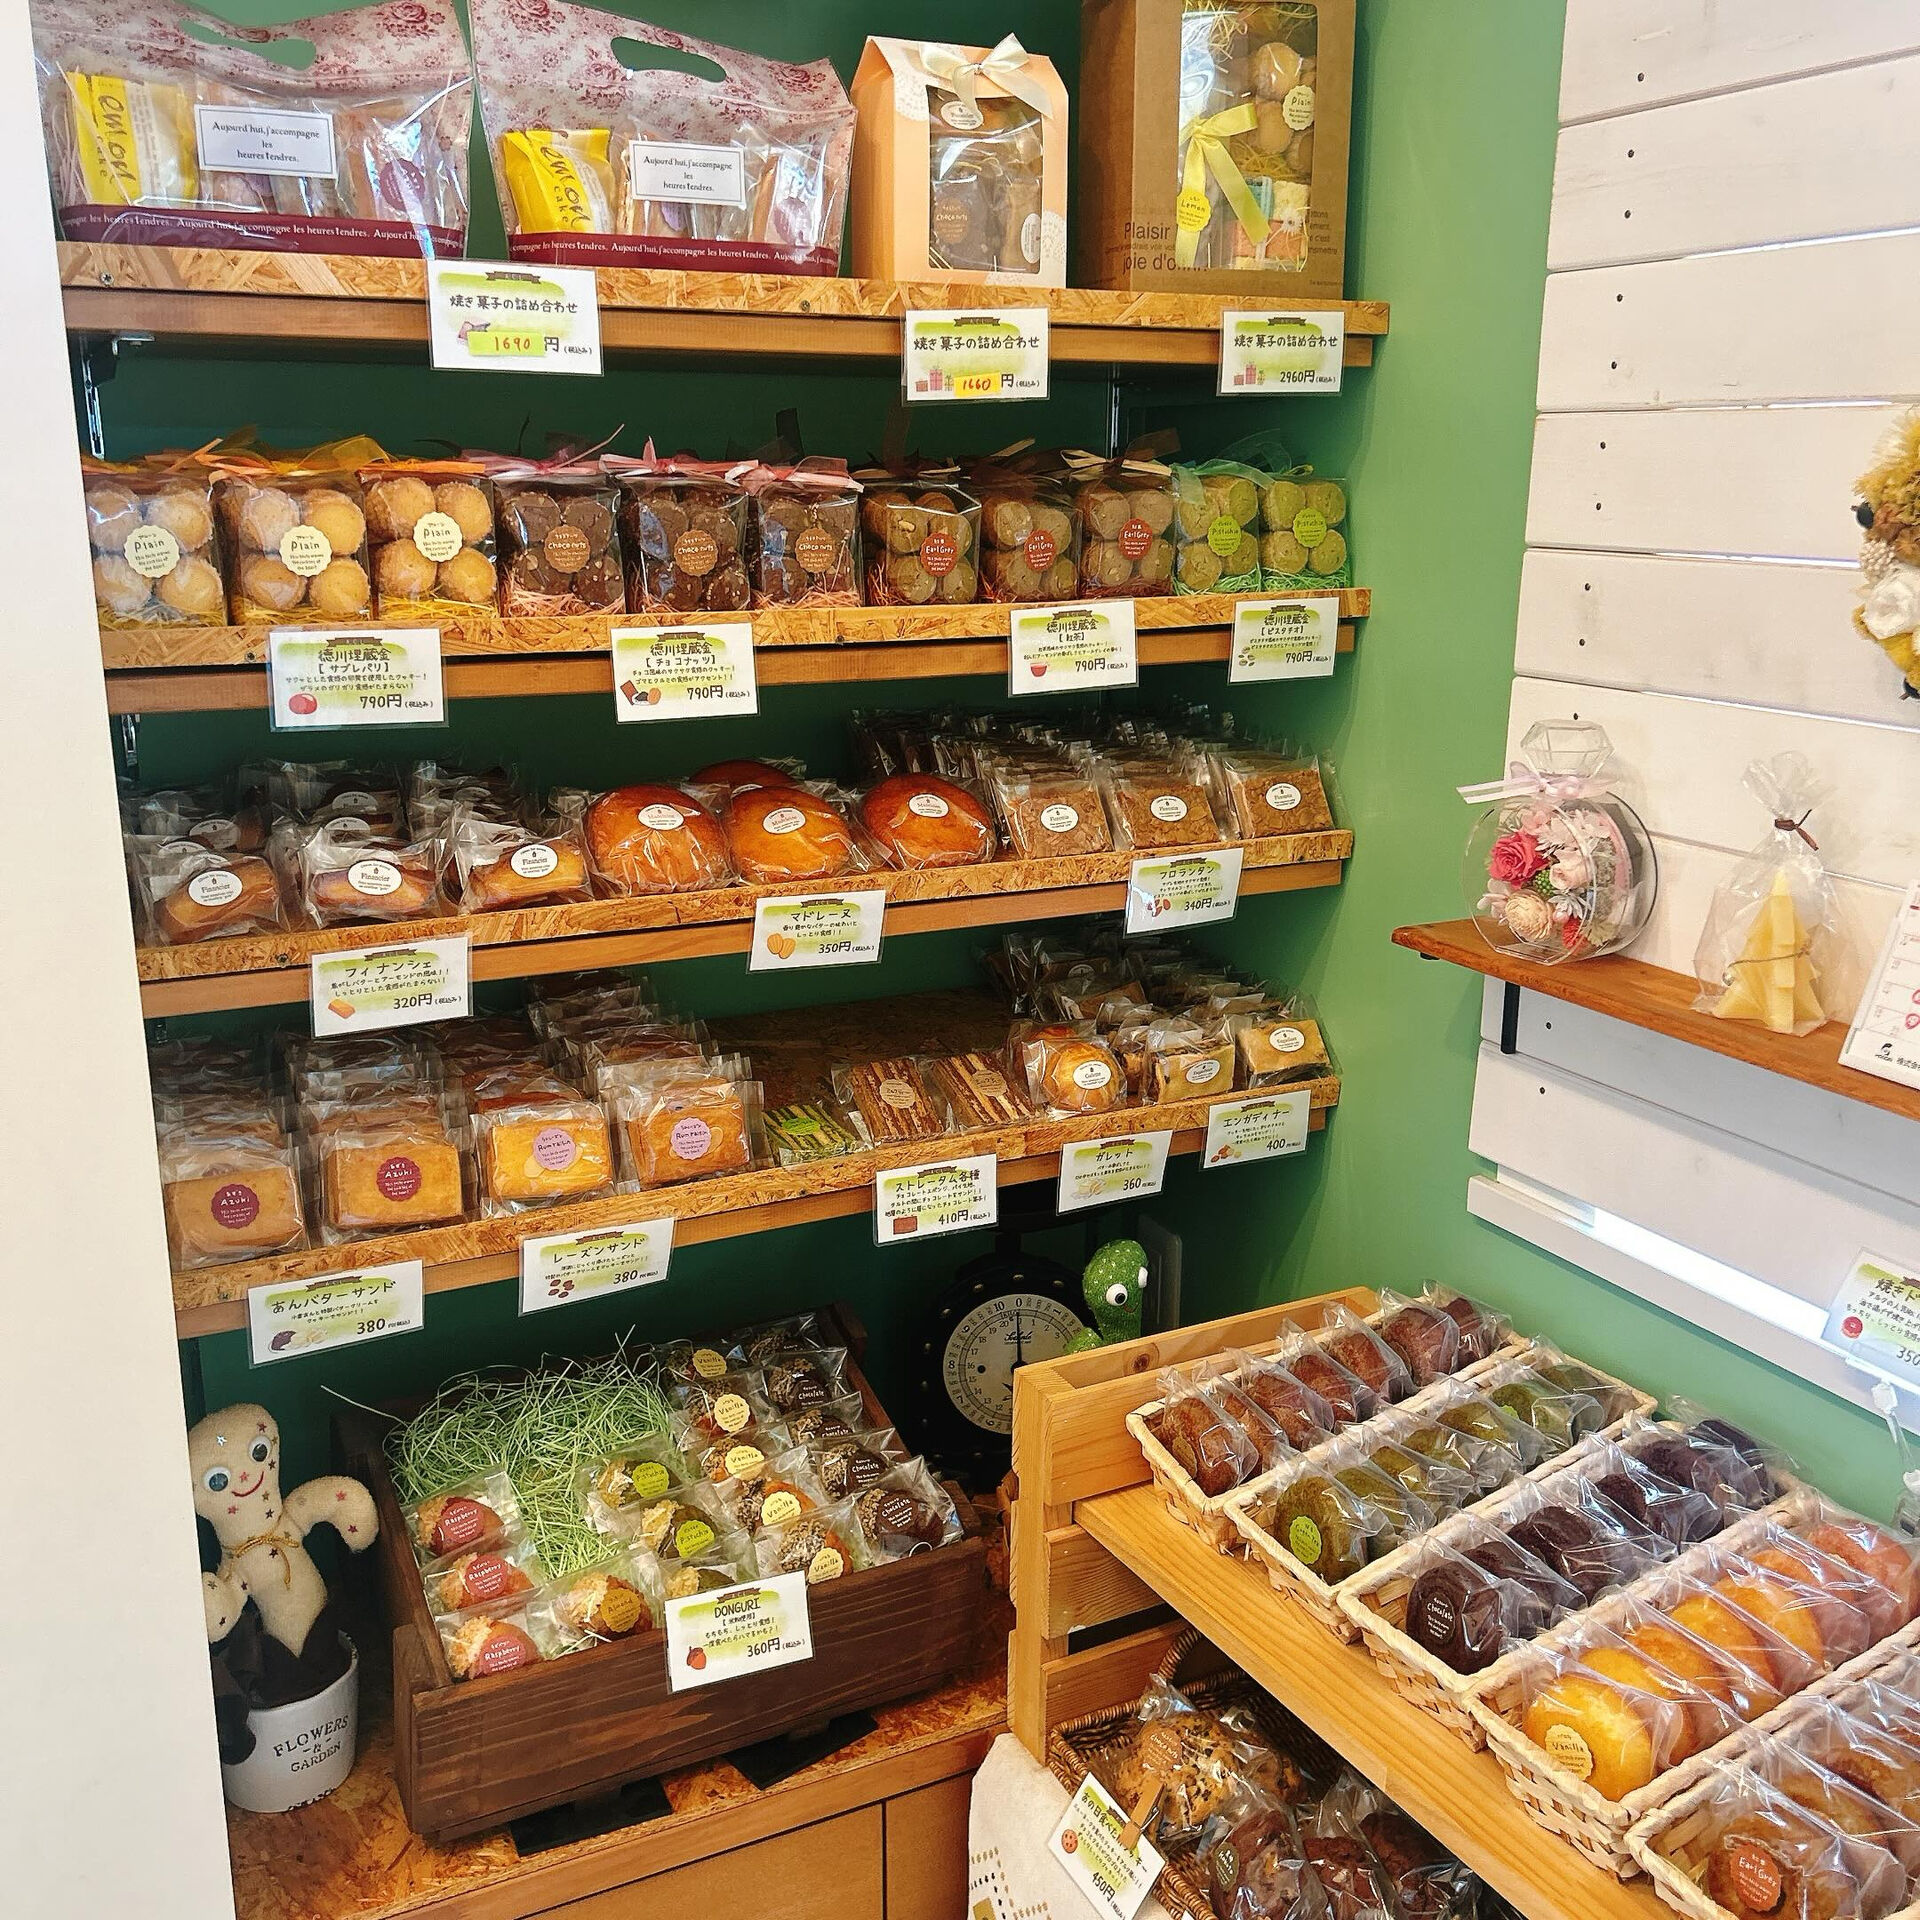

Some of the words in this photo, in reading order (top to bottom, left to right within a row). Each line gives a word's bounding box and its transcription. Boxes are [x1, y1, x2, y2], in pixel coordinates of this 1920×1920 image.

[262, 140, 273, 149] les
[684, 171, 694, 179] les
[663, 182, 687, 191] heures
[1181, 200, 1205, 213] Lemon
[293, 224, 305, 234] les
[306, 225, 335, 236] heures
[1124, 224, 1171, 240] Plaisir
[542, 240, 551, 250] les
[551, 240, 576, 250] heures
[707, 247, 717, 257] les
[718, 249, 742, 258] heures
[1122, 255, 1146, 275] joie
[450, 295, 578, 314] 焼き菓子の詰め合わせ
[914, 335, 1040, 351] 焼き菓子の詰め合わせ
[1234, 334, 1338, 348] 焼き菓子の詰め合わせ
[423, 529, 451, 540] Plain
[134, 540, 165, 553] Plain
[291, 541, 321, 552] Plain
[1046, 618, 1100, 634] 徳川埋蔵金
[318, 648, 391, 663] 徳川埋蔵金
[650, 641, 713, 656] 徳川埋蔵金
[1160, 865, 1215, 879] フロランタン
[791, 908, 851, 922] マドレーヌ
[345, 959, 432, 978] フィナンシェ
[1223, 1108, 1291, 1128] エンガディナー
[1096, 1147, 1133, 1162] ガレット
[384, 1168, 414, 1179] Azuki
[895, 1168, 981, 1193] ストレータム各種
[220, 1196, 250, 1207] Azuki
[553, 1237, 646, 1264] レーズンサンド
[272, 1280, 397, 1314] あんバターサンド
[1015, 1297, 1022, 1307] 0
[994, 1301, 1005, 1311] 10
[971, 1347, 979, 1355] 17
[948, 1360, 955, 1369] 8
[718, 1399, 744, 1416] Vanilla
[957, 1396, 965, 1405] 7
[730, 1451, 758, 1464] Vanilla
[851, 1462, 881, 1474] Chocolate
[766, 1500, 793, 1517] Vanilla
[881, 1497, 911, 1517] Chocolate
[444, 1507, 478, 1527] Raspberry
[468, 1562, 501, 1582] Raspberry
[714, 1597, 761, 1619] DONGURI
[1426, 1602, 1454, 1623] Chocolate
[484, 1643, 521, 1661] Raspberry
[272, 1714, 349, 1757] FLOWERS
[1552, 1741, 1585, 1753] Vanilla
[290, 1740, 341, 1773] GARDEN
[1738, 1856, 1758, 1874] Earl
[1758, 1868, 1777, 1887] Grey
